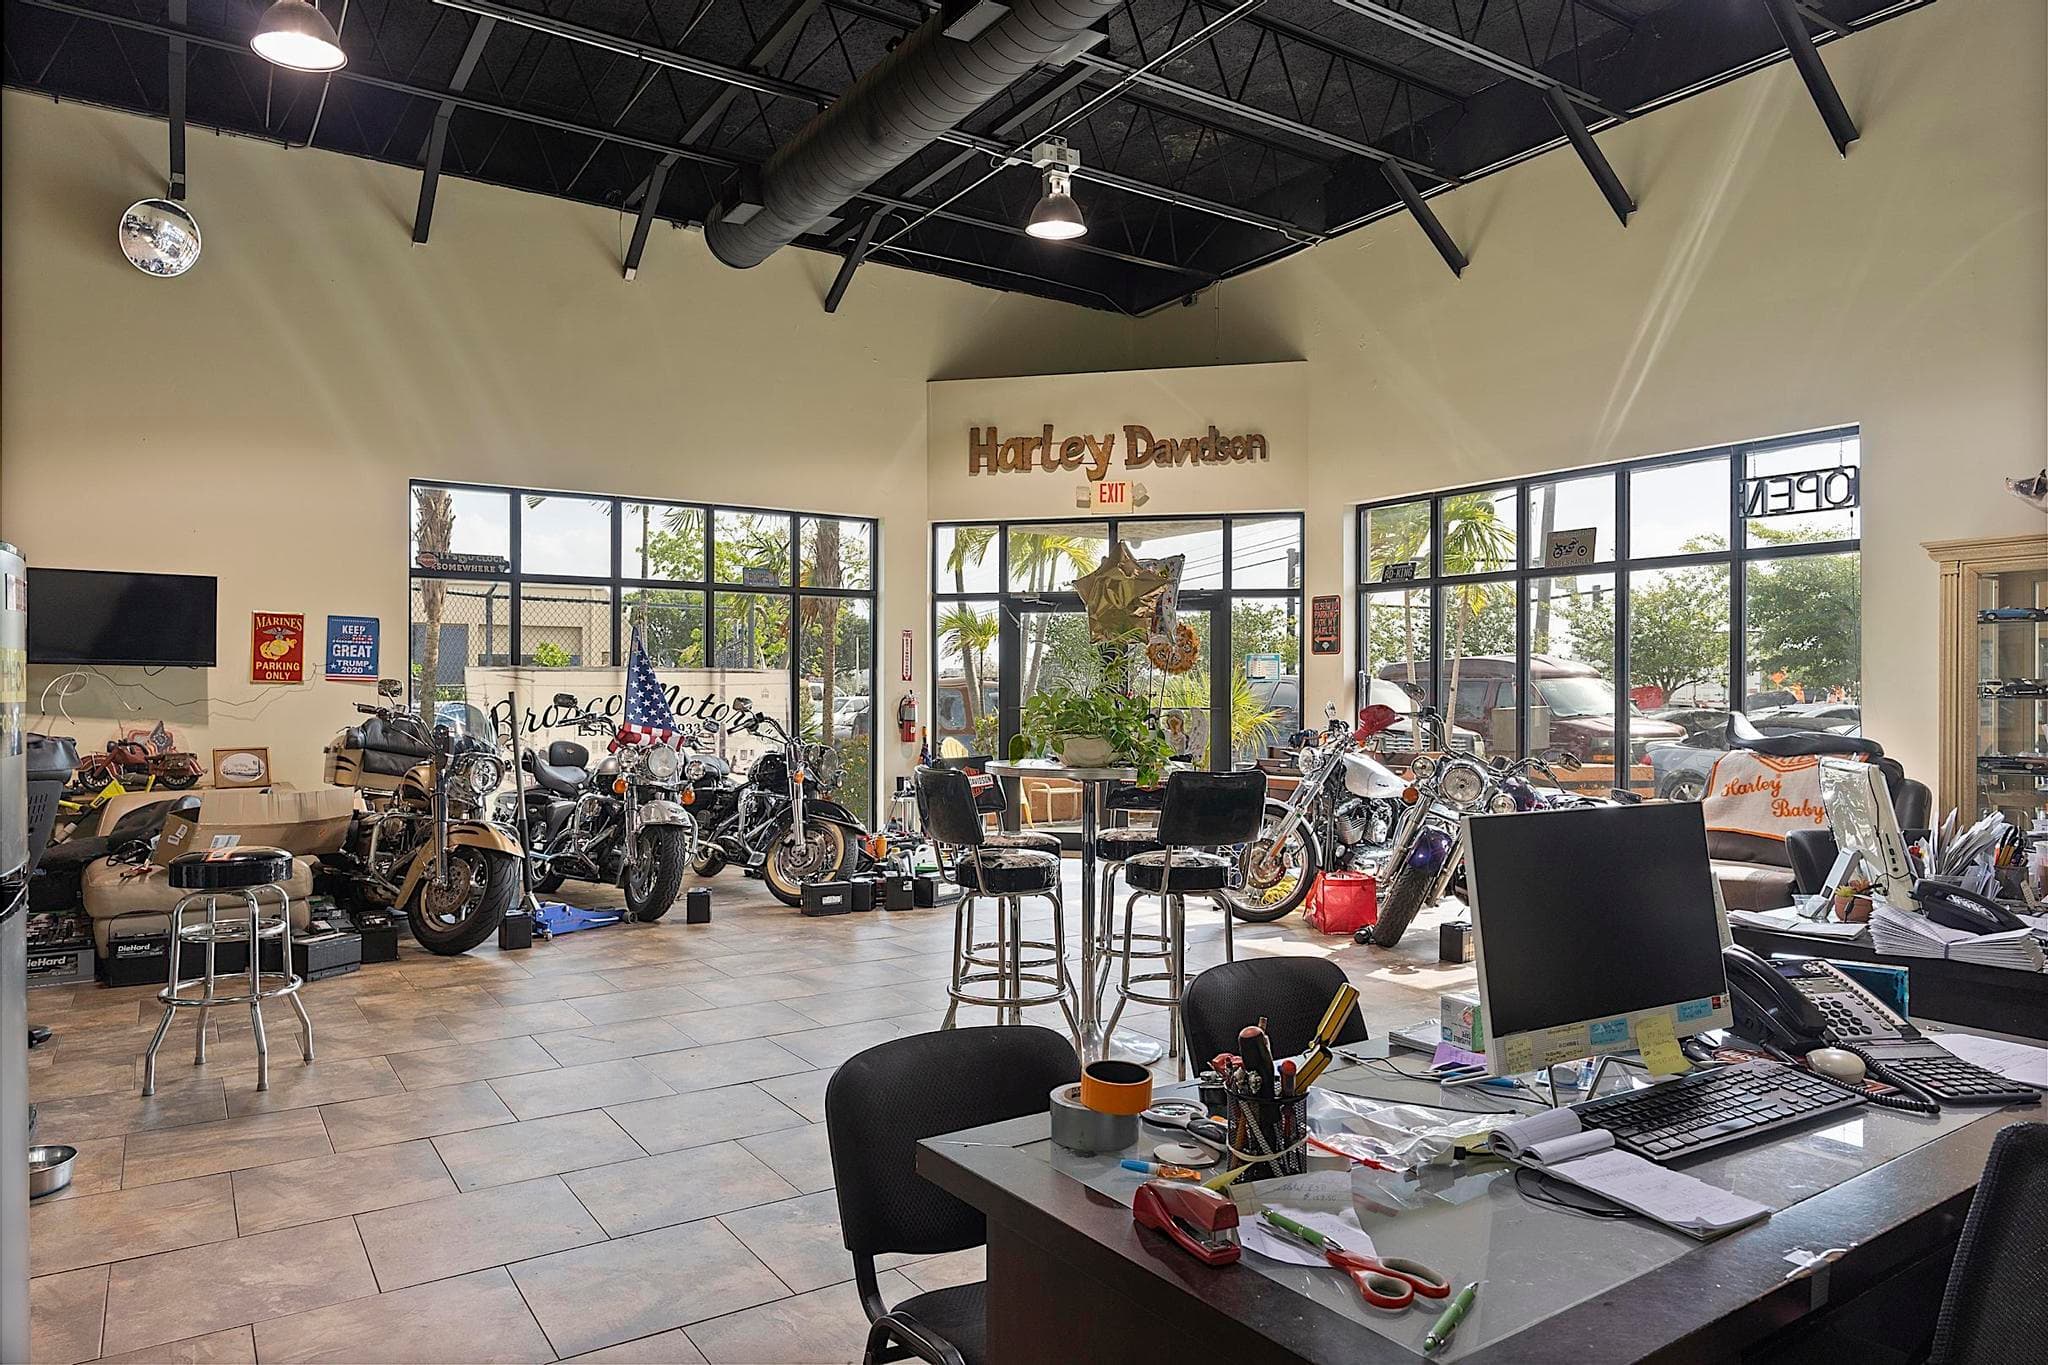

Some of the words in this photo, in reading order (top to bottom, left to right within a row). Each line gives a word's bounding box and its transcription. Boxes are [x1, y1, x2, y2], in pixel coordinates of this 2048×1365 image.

[969, 424, 1115, 482] Harley
[1123, 425, 1266, 467] Davidson
[1100, 483, 1125, 502] EXIT
[437, 563, 496, 573] SOMEWHERE
[256, 616, 303, 631] MARINES
[342, 625, 366, 635] KEEP
[332, 644, 373, 658] GREAT
[256, 661, 300, 671] PARKING
[265, 672, 291, 680] ONLY
[1721, 775, 1782, 797] Harley
[1771, 799, 1824, 824] Baby
[118, 944, 150, 952] DieHard
[27, 956, 67, 967] ieHard
